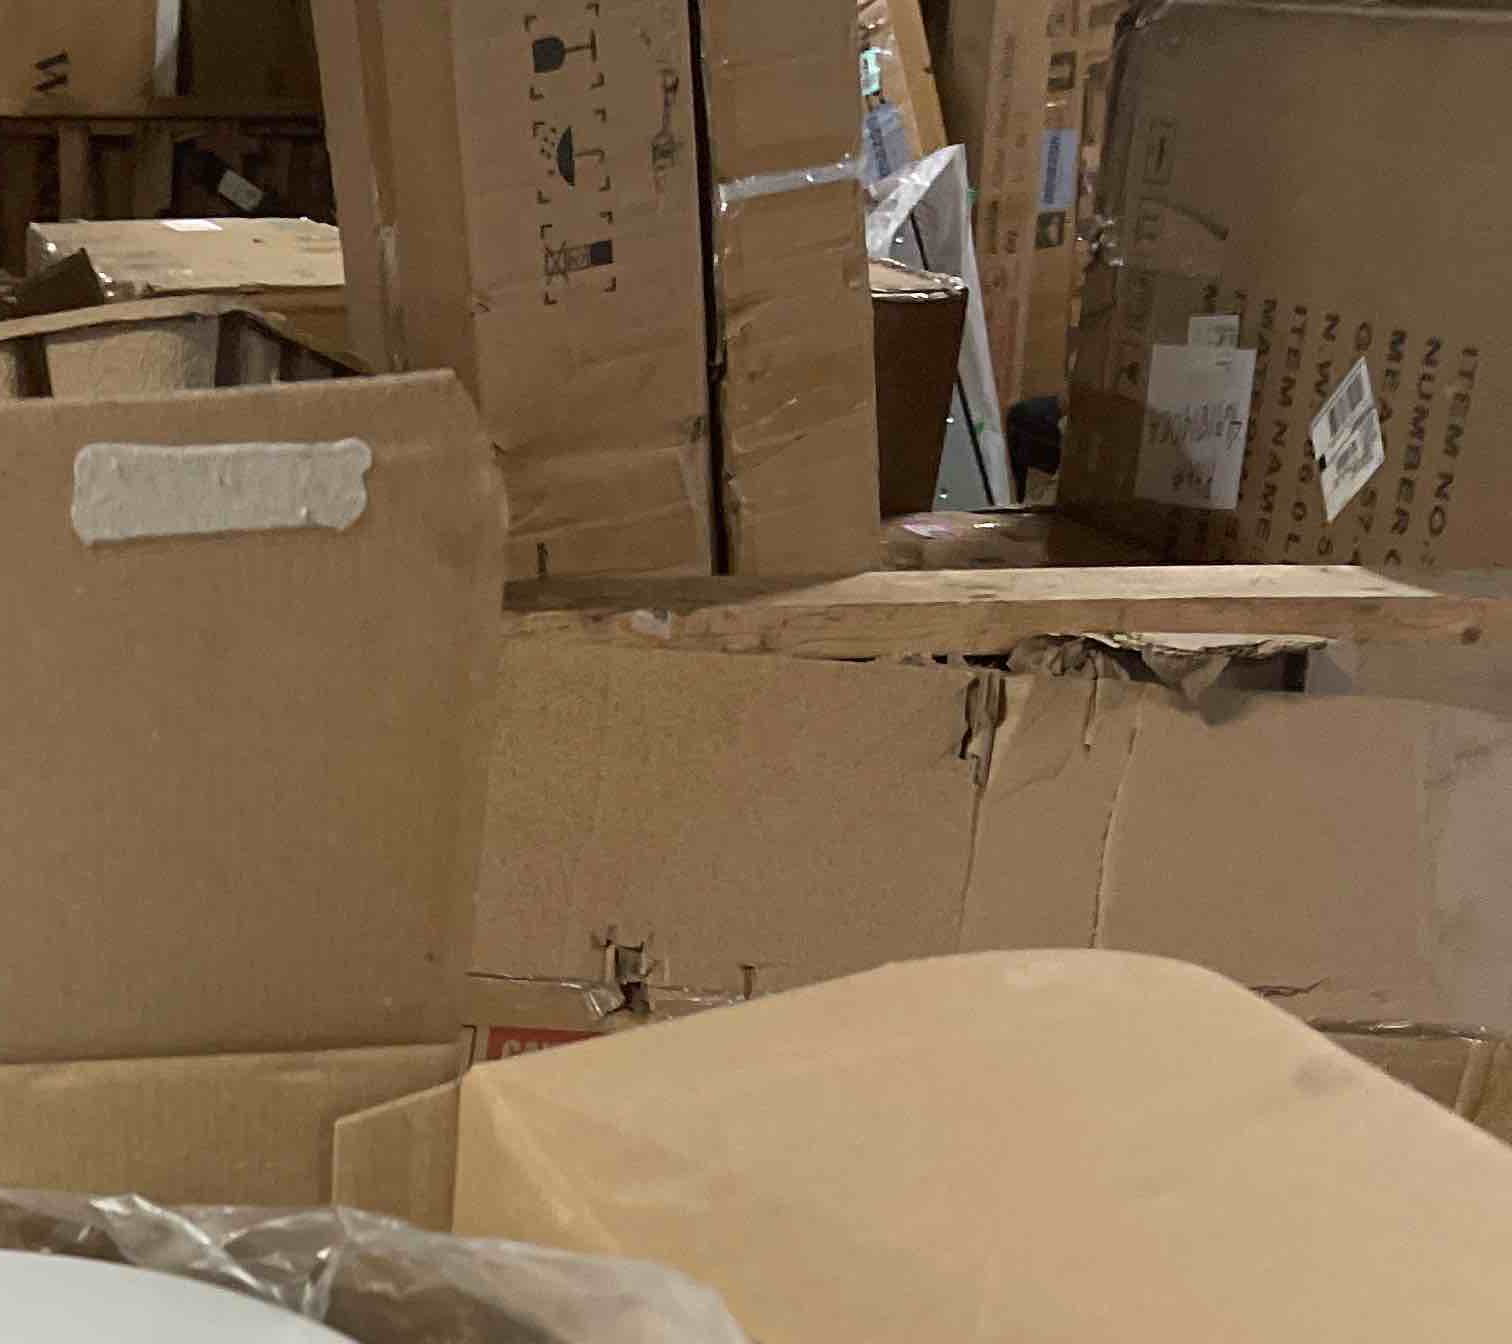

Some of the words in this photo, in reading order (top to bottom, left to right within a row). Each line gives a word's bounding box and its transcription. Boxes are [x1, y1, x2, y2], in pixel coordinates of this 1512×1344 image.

[1279, 304, 1307, 408] ITEM
[1444, 347, 1478, 457] ITEM
[1392, 336, 1441, 535] NUMBER
